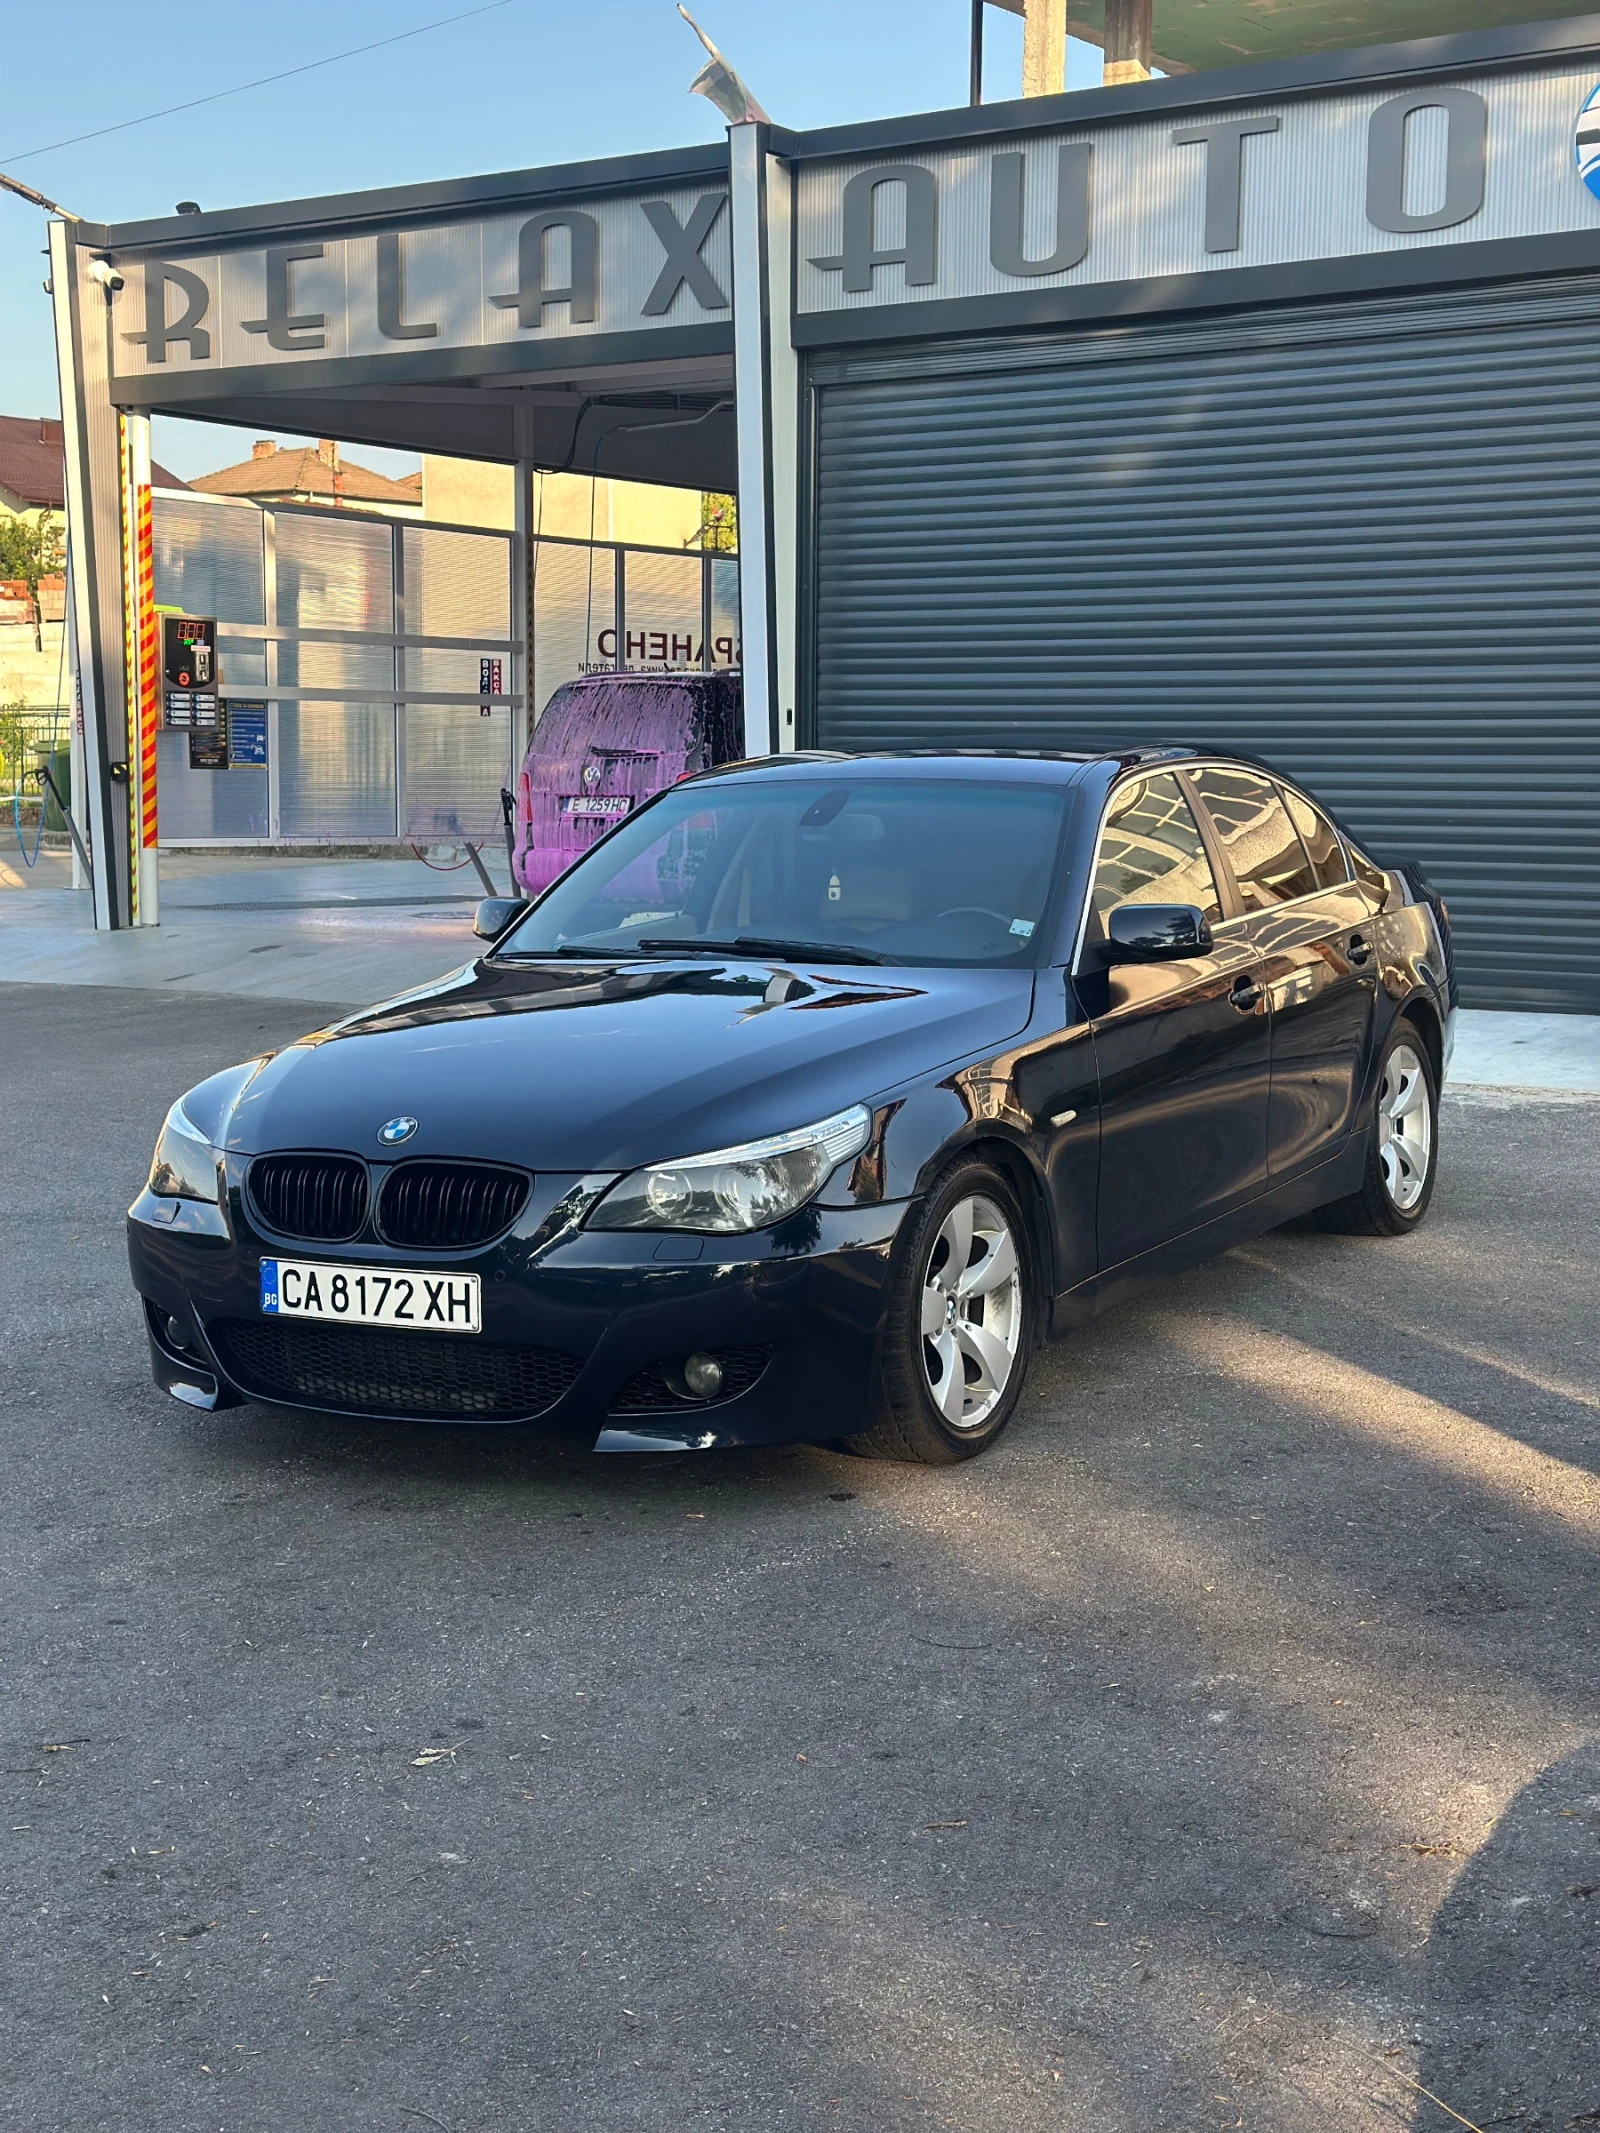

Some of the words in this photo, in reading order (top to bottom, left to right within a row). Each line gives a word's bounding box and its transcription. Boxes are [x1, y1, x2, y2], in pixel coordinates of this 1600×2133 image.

[806, 88, 1486, 292] AUTO
[121, 193, 728, 363] RELAX
[572, 799, 580, 812] E
[586, 798, 610, 812] 1259
[265, 1293, 277, 1305] BG
[282, 1269, 323, 1311] CA
[331, 1274, 414, 1319] 8172
[423, 1280, 471, 1323] XH
